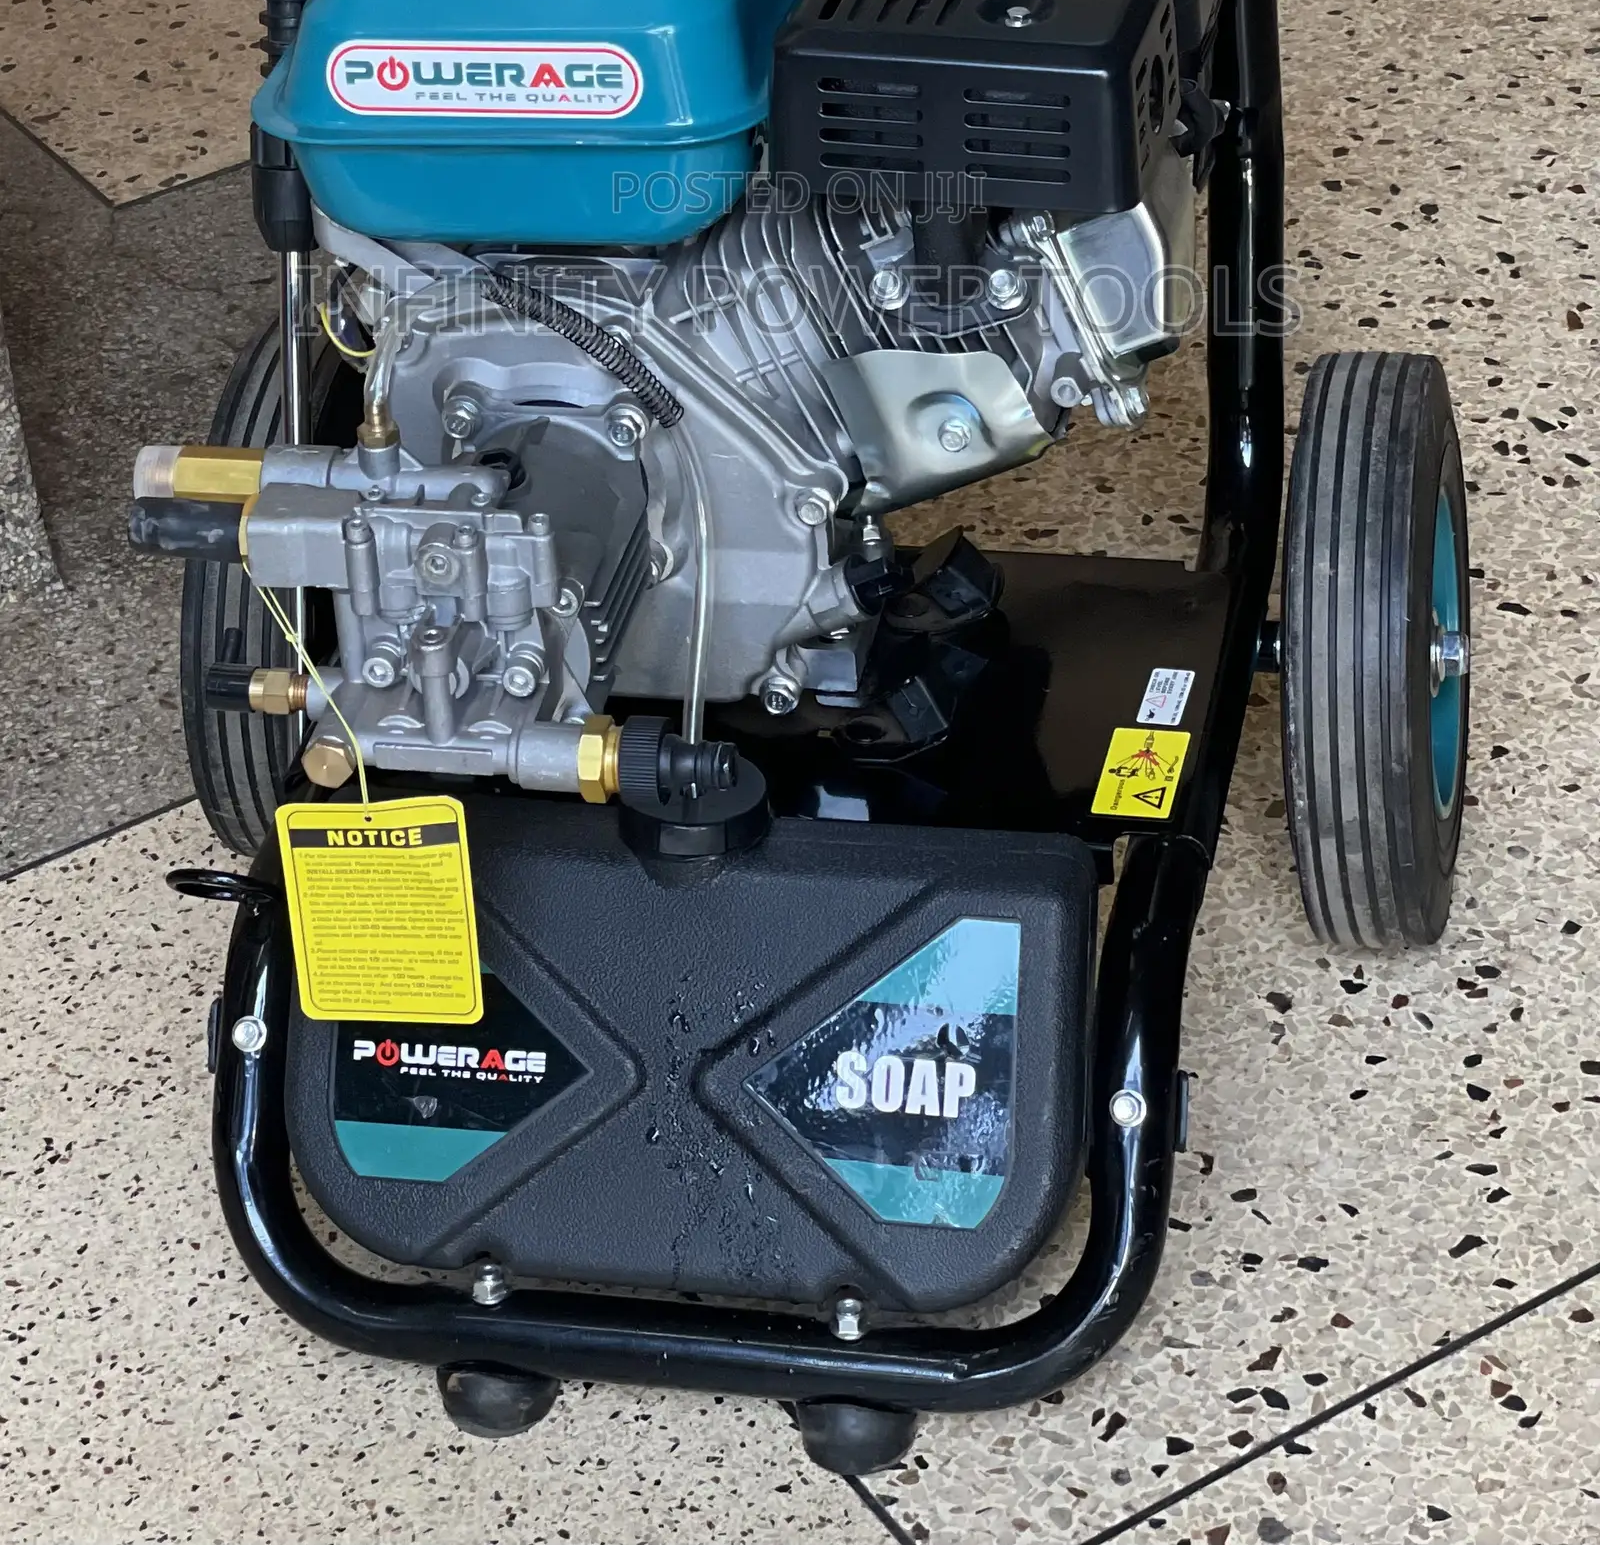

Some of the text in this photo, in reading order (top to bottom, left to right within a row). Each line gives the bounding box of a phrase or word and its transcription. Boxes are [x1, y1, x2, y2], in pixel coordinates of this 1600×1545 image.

[344, 55, 624, 92] POWERAGE
[415, 91, 623, 104] FEEL THE QUALITY
[1110, 779, 1125, 810] Dangerous
[326, 828, 423, 847] NOTICE
[353, 1038, 547, 1073] POWERAGE
[400, 1066, 544, 1084] FEEL THE QUALITY
[834, 1051, 978, 1120] SOAP
